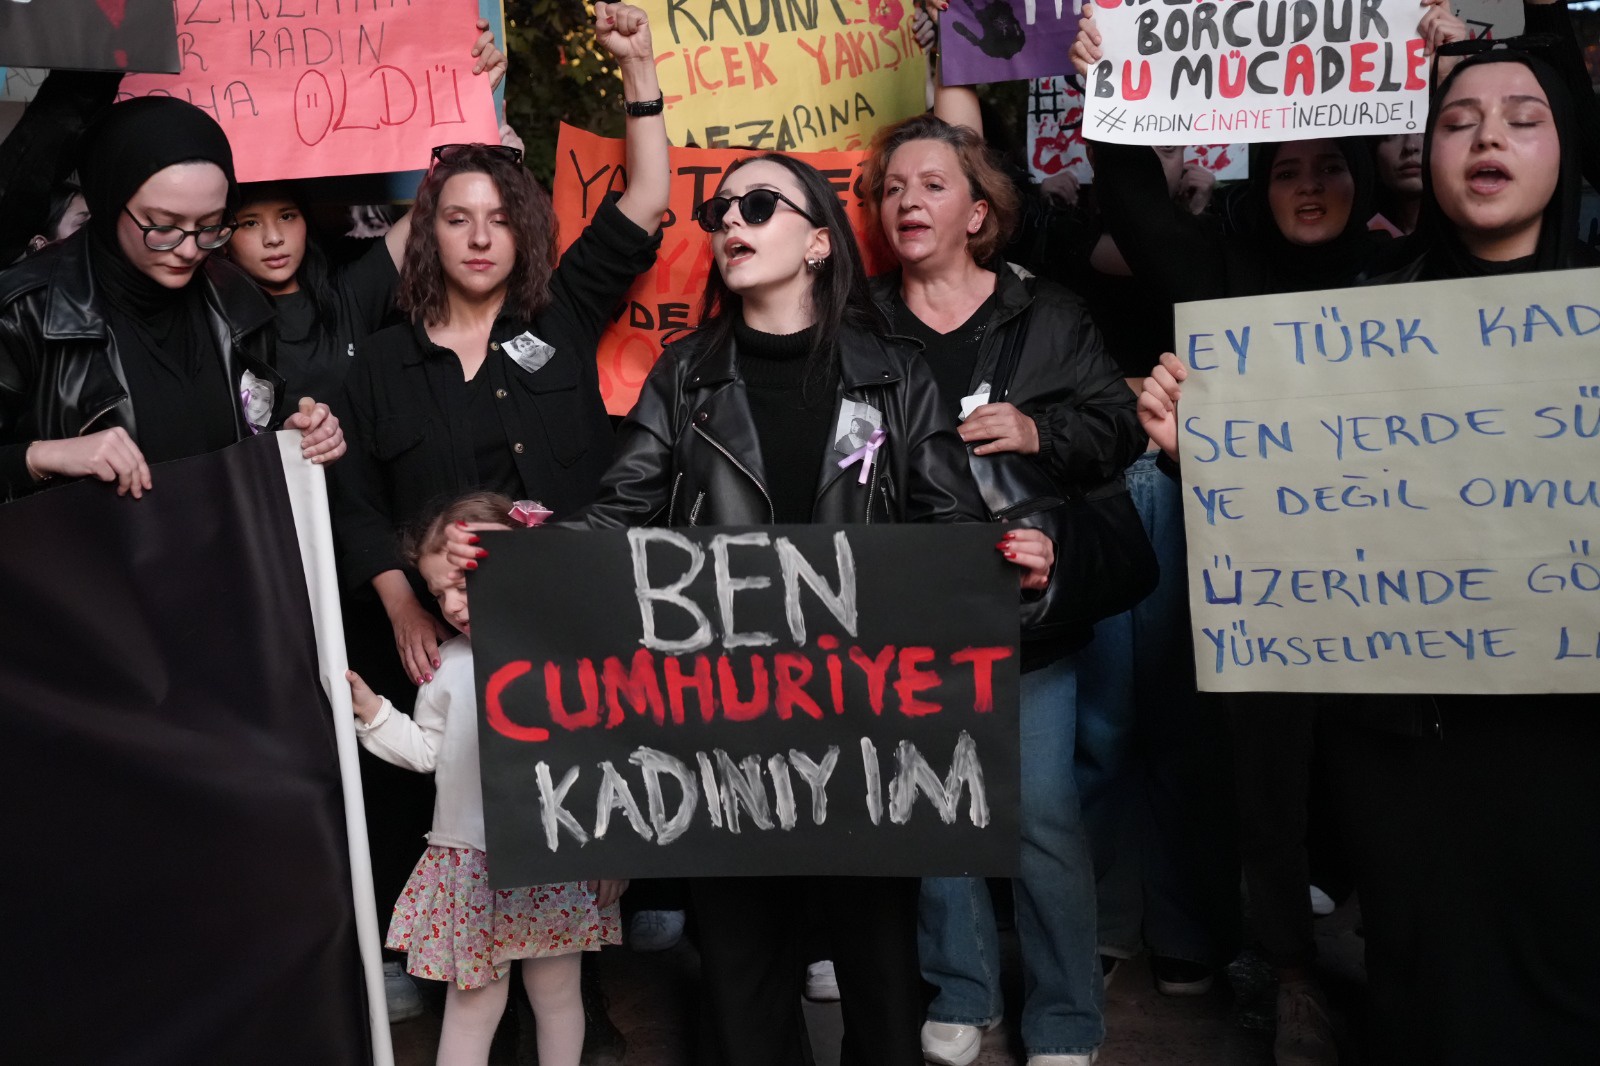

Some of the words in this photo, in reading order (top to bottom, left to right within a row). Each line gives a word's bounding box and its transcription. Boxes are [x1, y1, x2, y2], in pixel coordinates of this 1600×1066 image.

[249, 22, 384, 68] KADIN
[1135, 0, 1389, 55] BORCUDUR
[1093, 59, 1152, 101] BU
[1170, 38, 1426, 100] MÜCADELE
[294, 65, 466, 147] ÖLDÜ
[667, 92, 875, 153] EZARINA
[1188, 325, 1251, 375] EY
[1273, 306, 1439, 364] TÜRK
[1478, 305, 1600, 347] KAD
[1185, 416, 1294, 462] SEN
[1320, 408, 1506, 461] YERDE
[1534, 385, 1600, 438] SÜ
[1192, 486, 1246, 525] YE
[1276, 468, 1430, 516] DEĞİL
[626, 526, 858, 655] BEN
[1202, 549, 1500, 608] ÜZERİNDE
[1527, 540, 1600, 593] GÖ
[1201, 619, 1517, 673] YÜKSELMEYE
[1554, 626, 1600, 660] L
[486, 635, 1014, 742] CUMHURİYET
